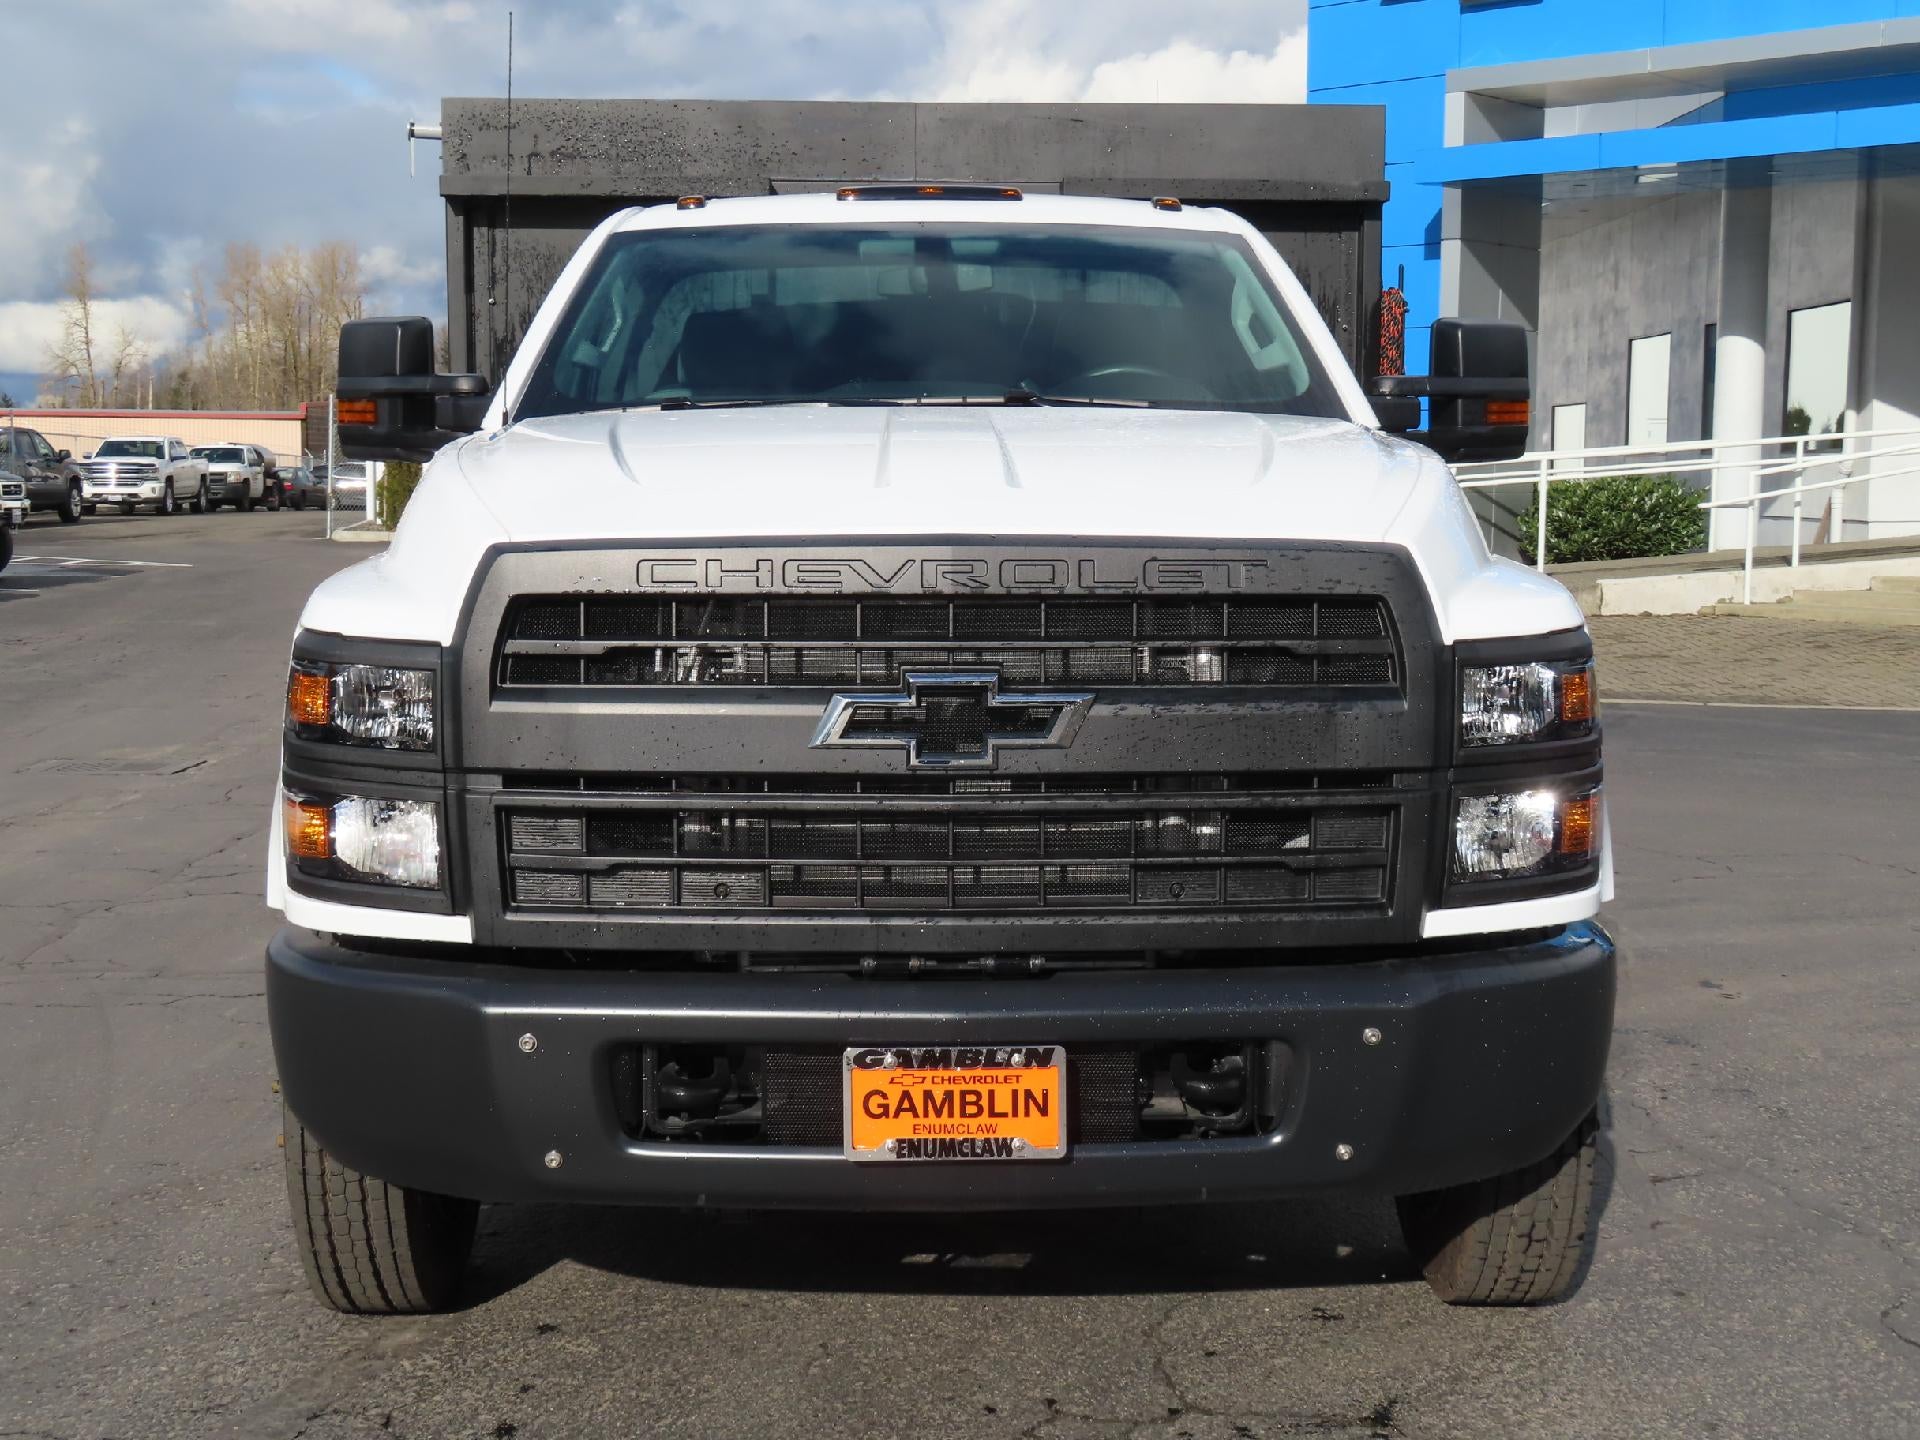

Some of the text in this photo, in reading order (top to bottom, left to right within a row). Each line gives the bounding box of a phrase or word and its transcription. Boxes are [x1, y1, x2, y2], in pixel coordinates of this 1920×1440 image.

[636, 558, 1269, 590] CHEVROLET
[931, 1074, 1023, 1085] CHEVROLET
[862, 1088, 1049, 1119] GAMBLIN
[912, 1123, 999, 1135] ENUMCLAW
[895, 1137, 1014, 1159] ENUMCLAW
